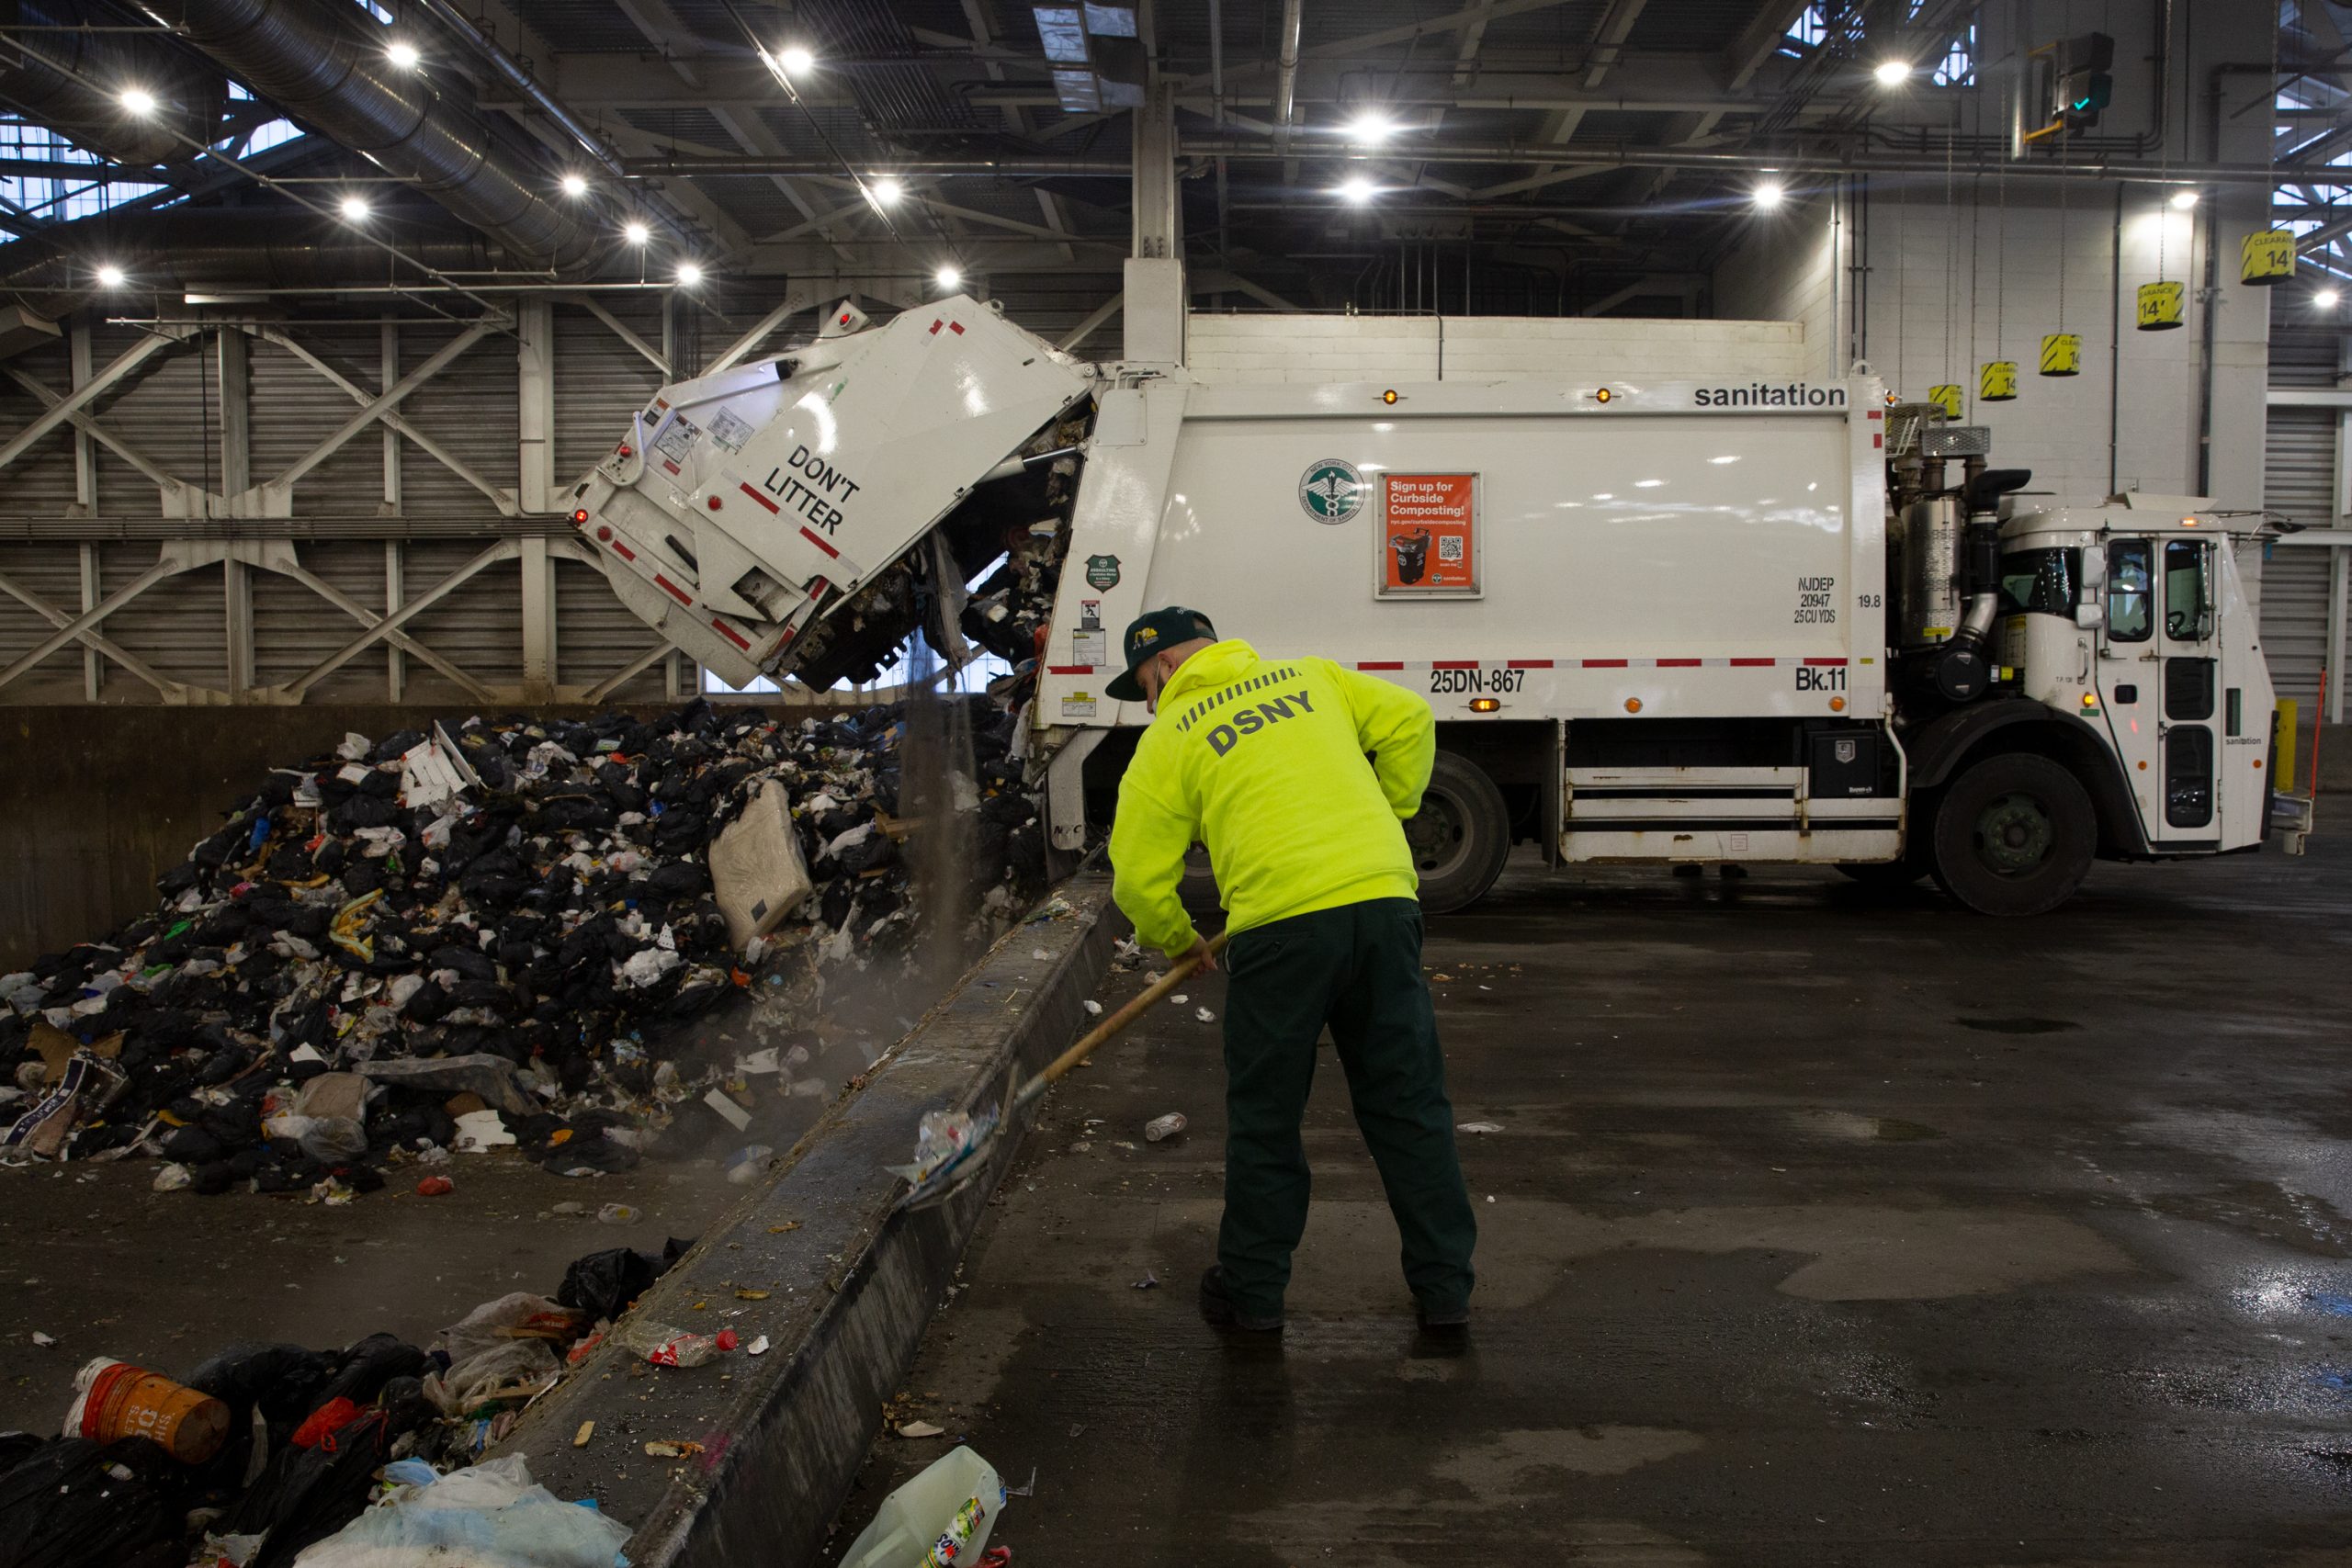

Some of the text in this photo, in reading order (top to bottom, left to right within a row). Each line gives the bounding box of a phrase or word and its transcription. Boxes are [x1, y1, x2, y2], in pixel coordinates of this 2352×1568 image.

[2141, 300, 2165, 318] 14'
[2004, 377, 2016, 390] 14
[1694, 382, 1846, 407] sanitation
[787, 444, 861, 506] DON'T
[1310, 462, 1323, 473] NEW
[1341, 463, 1354, 474] CITY
[1390, 480, 1453, 493] Sign up for
[763, 467, 843, 536] LITTER
[1390, 493, 1444, 503] Curbside
[1390, 505, 1464, 517] Composting!
[1798, 577, 1834, 592] NJDEP
[1801, 593, 1830, 607] 20947
[1858, 594, 1881, 608] 19.8
[1794, 609, 1836, 624] 25 CU YDS
[1430, 669, 1525, 694] 25DN-867
[1795, 667, 1846, 692] Bk.11
[1205, 690, 1315, 758] DSNY
[2225, 737, 2262, 746] sanitation
[125, 1404, 141, 1435] ET'S
[154, 1412, 175, 1442] HIS.
